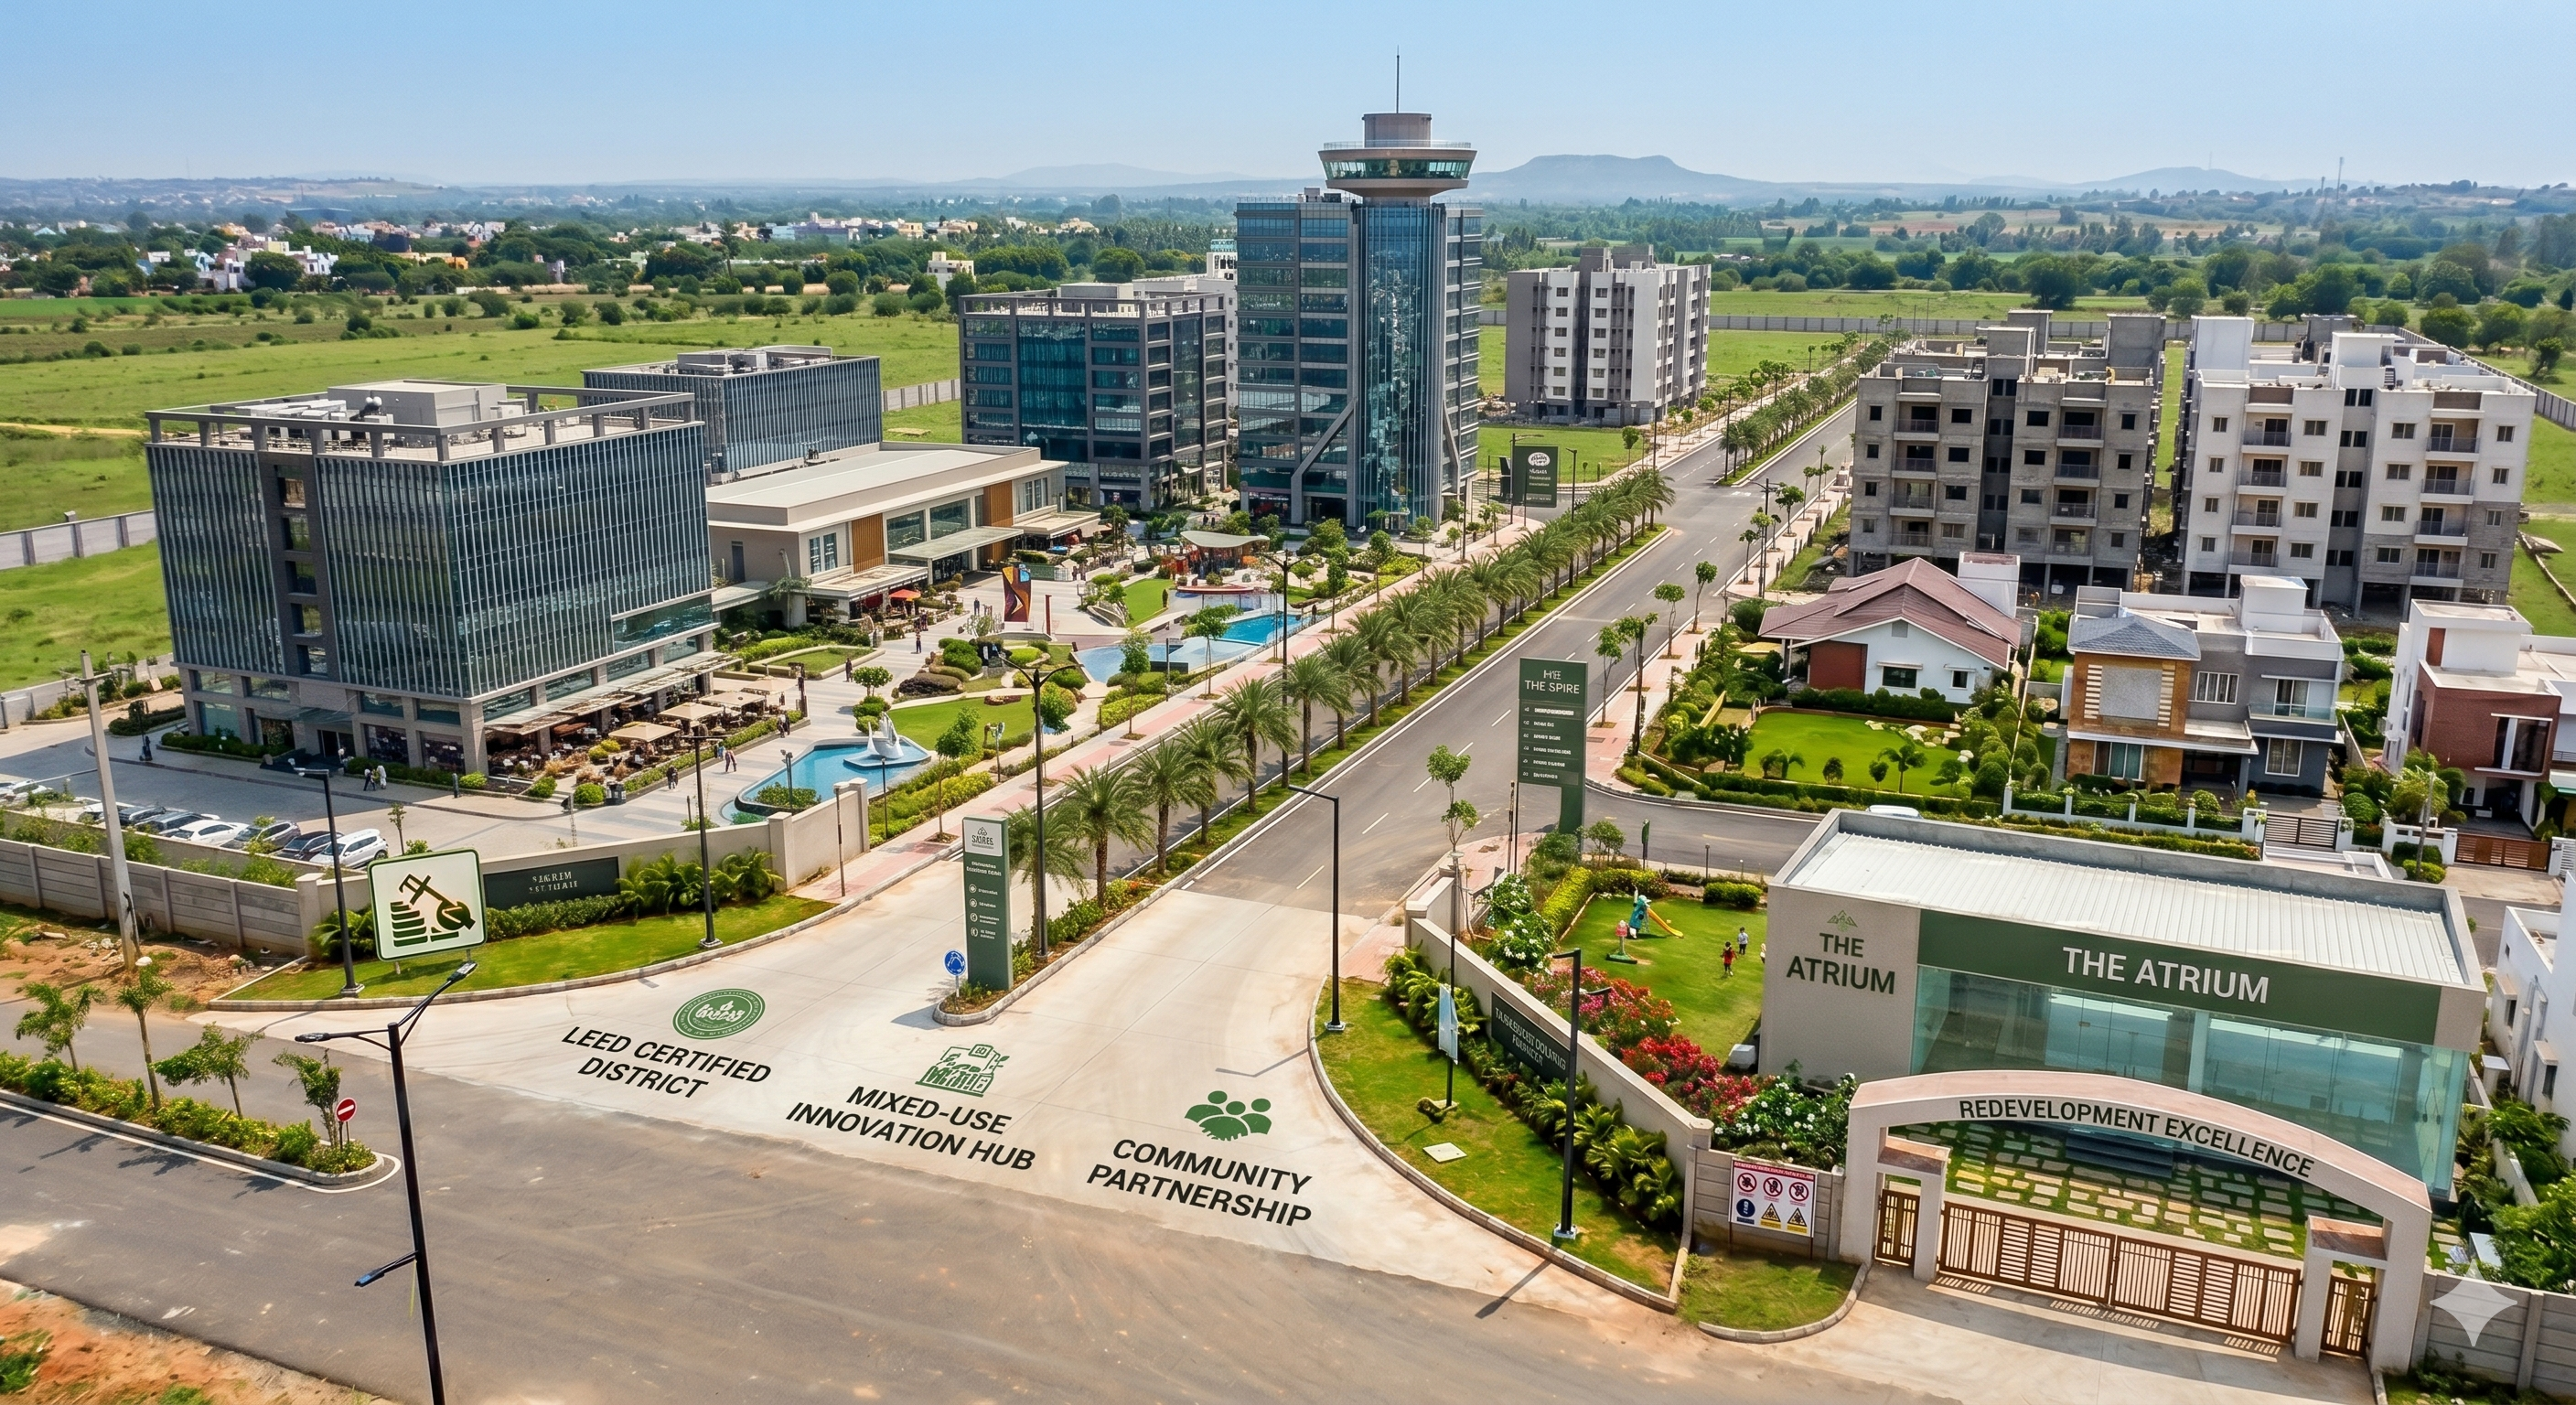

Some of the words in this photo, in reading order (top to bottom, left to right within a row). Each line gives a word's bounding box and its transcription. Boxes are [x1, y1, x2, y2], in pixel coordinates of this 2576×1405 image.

[1524, 680, 1546, 692] THE
[1548, 682, 1580, 694] SPIRE
[1819, 932, 1865, 959] THE
[1786, 955, 1895, 995] ATRIUM
[2063, 946, 2127, 981] THE
[2134, 959, 2269, 1003] ATRIUM
[562, 1026, 632, 1053] LEED
[633, 1041, 772, 1083] CERTIFIED
[577, 1056, 709, 1099] DISTRICT
[786, 1102, 967, 1156] INNOVATION
[967, 1140, 1036, 1170] HUB
[845, 1086, 1013, 1135] MIXED-USE
[1959, 1099, 2161, 1134] REDEVELOPMENT
[2164, 1117, 2315, 1178] EXCELLENCE
[1112, 1139, 1313, 1195] COMMUNITY
[1086, 1164, 1312, 1227] PARTNERSHIP
